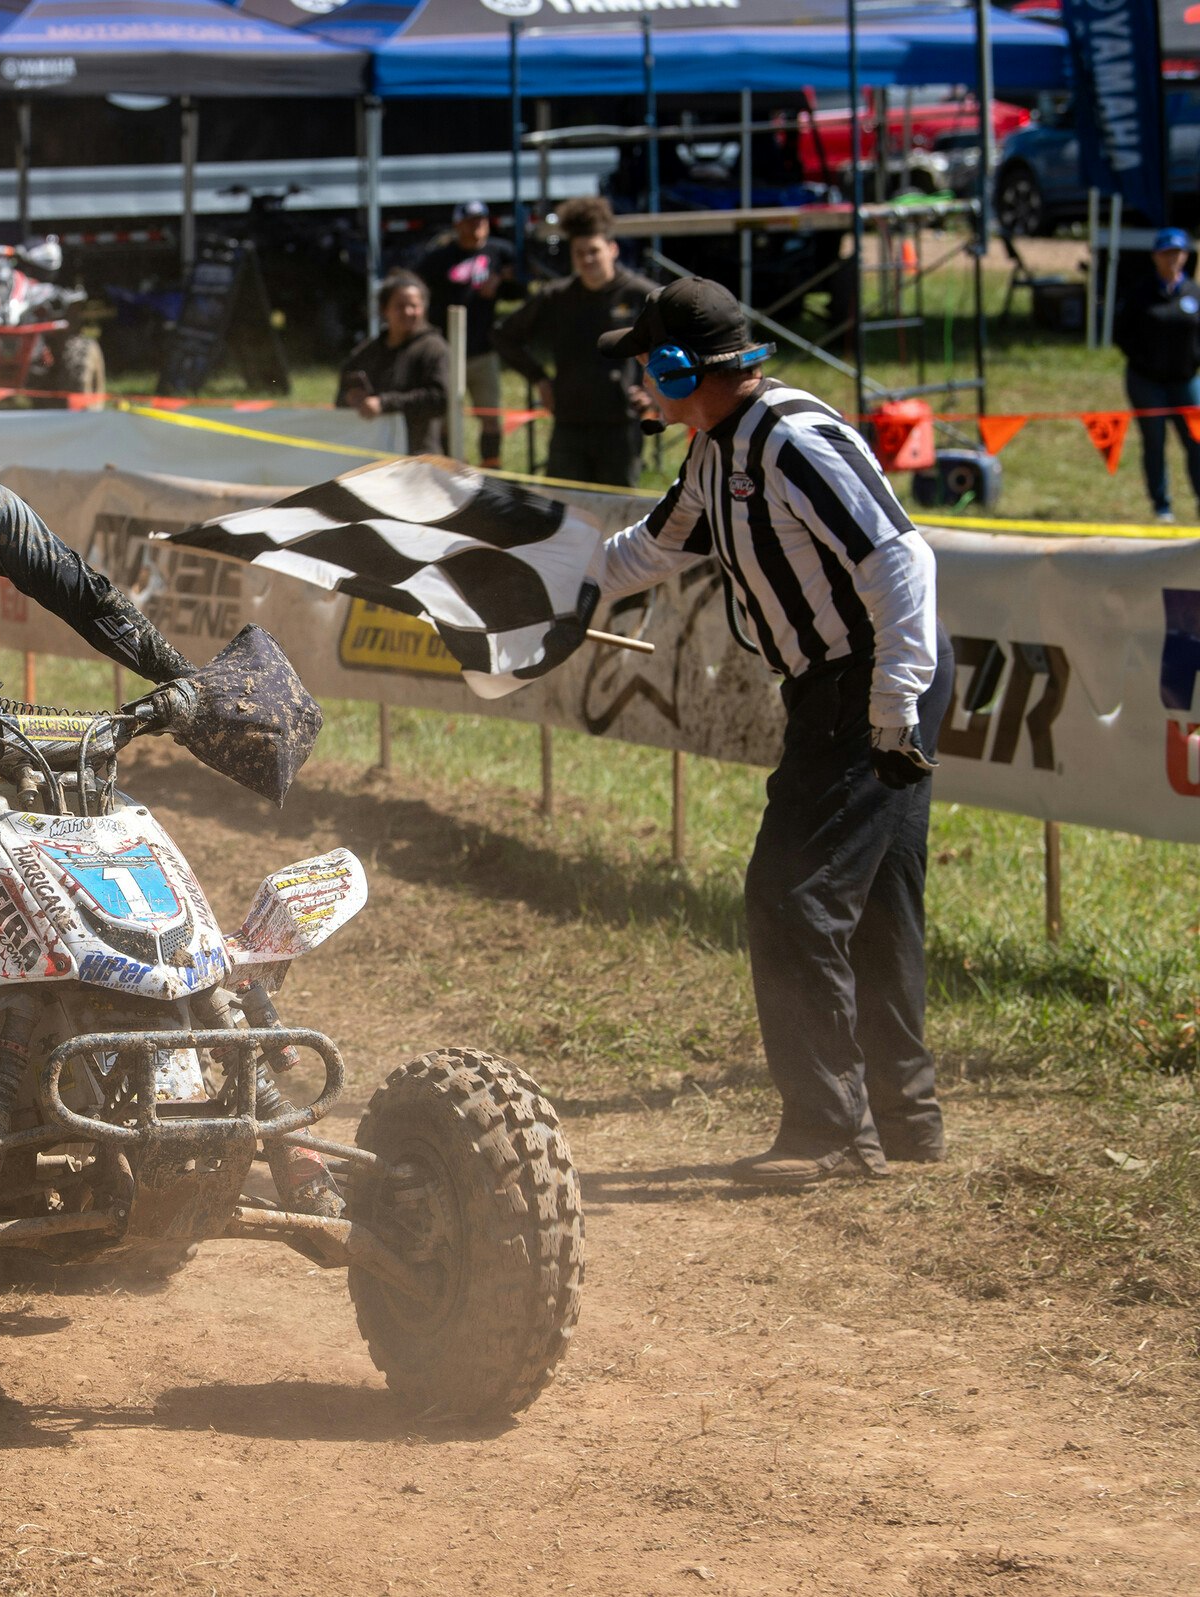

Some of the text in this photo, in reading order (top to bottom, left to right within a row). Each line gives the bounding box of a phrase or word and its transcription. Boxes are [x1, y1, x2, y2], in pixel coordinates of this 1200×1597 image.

[1089, 11, 1142, 171] YAMAHA
[351, 625, 422, 655] UTILITY
[12, 846, 78, 936] HURRICANE
[102, 867, 152, 914] 1
[79, 953, 154, 984] HiPer
